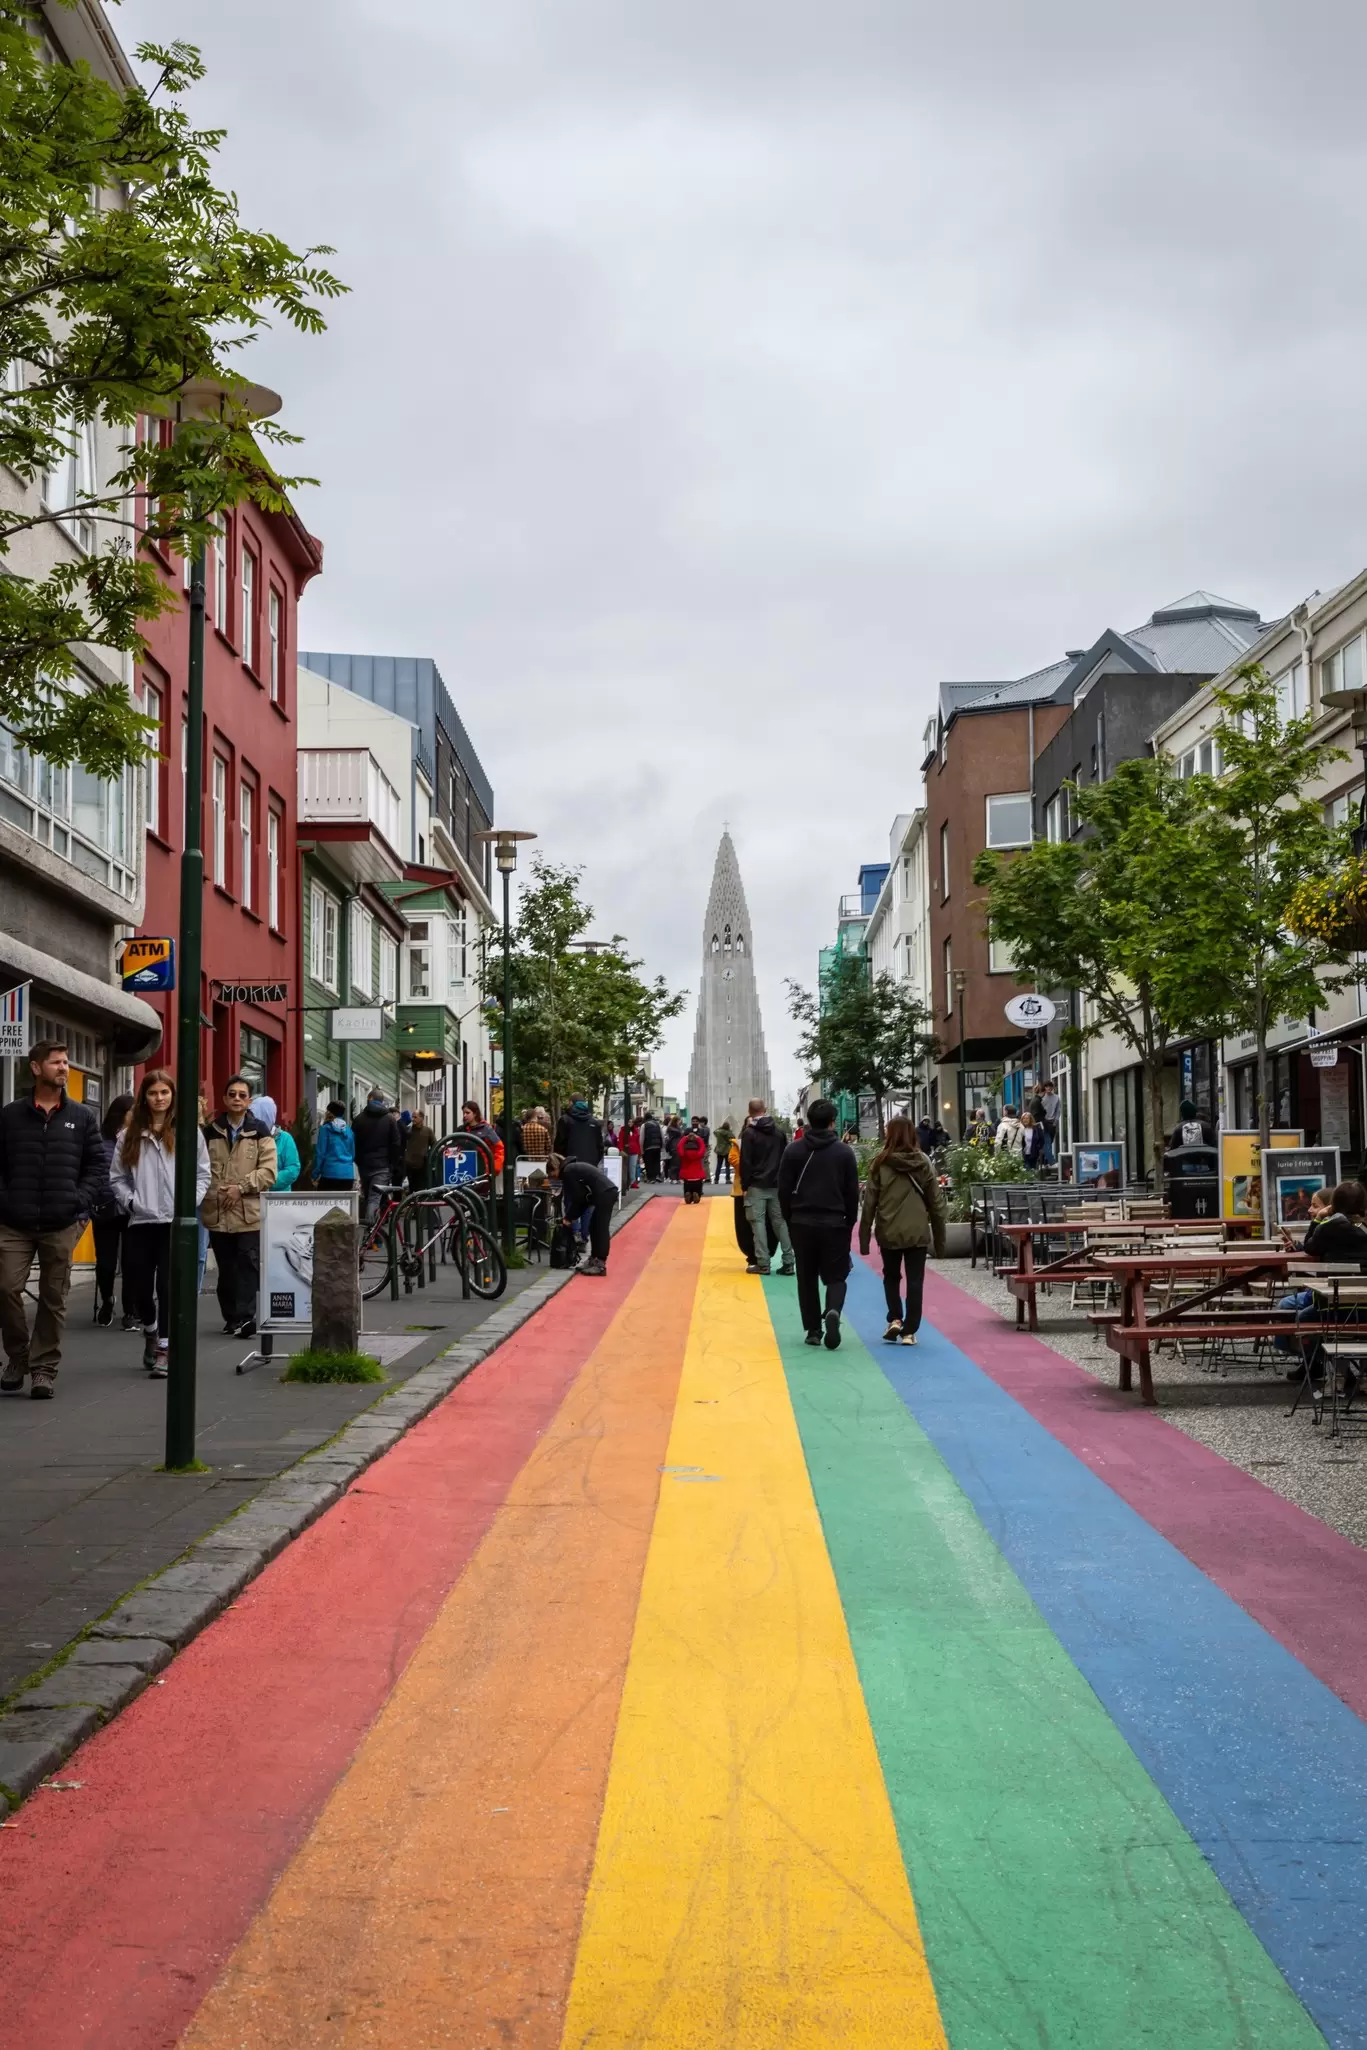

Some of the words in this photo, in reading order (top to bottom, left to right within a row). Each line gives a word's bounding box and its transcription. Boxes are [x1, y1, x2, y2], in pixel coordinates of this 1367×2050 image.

[128, 943, 164, 956] ATM
[222, 984, 285, 1004] MOKKA
[336, 1016, 377, 1028] Kaolin
[2, 1025, 23, 1036] FREE
[455, 1152, 467, 1169] P
[1298, 1160, 1312, 1168] fine
